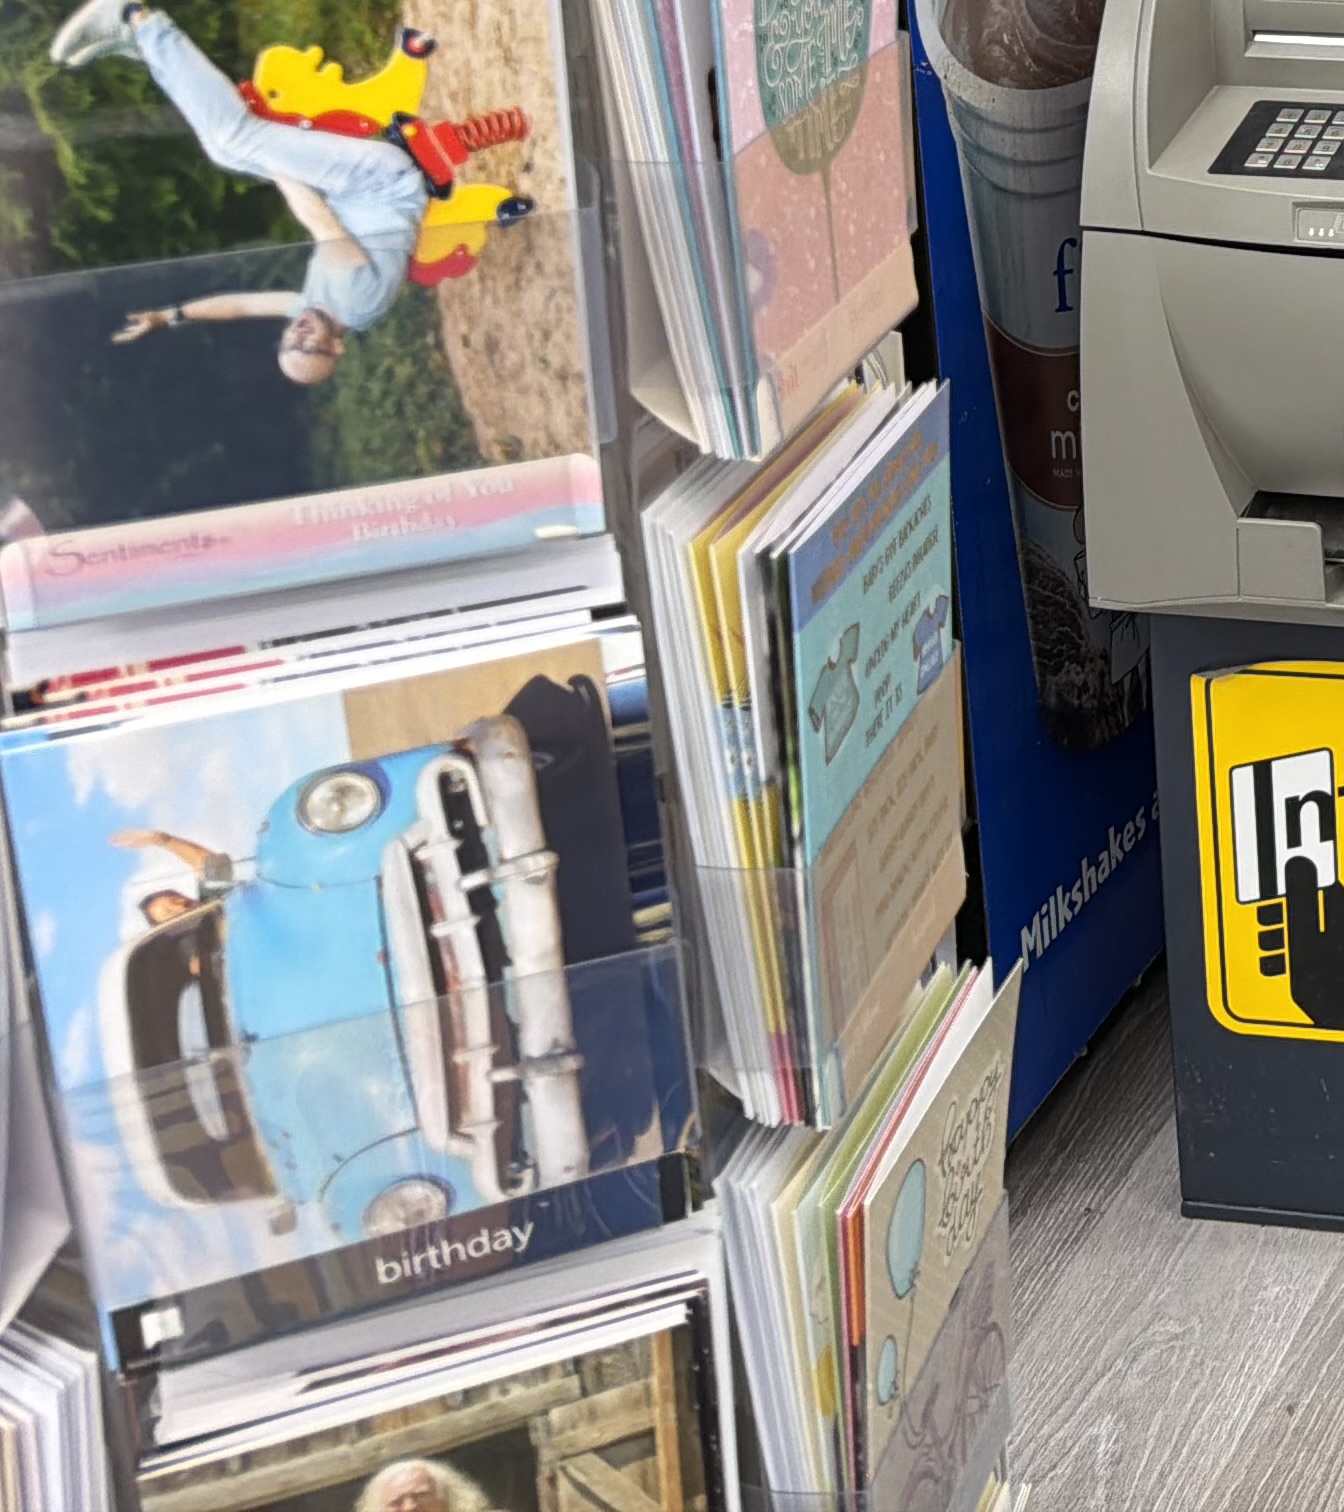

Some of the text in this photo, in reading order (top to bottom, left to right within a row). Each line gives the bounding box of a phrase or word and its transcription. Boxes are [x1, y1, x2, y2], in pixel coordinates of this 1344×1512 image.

[290, 488, 420, 528] Thinking
[351, 510, 459, 544] Birthday
[1020, 804, 1148, 975] Milkshakes
[375, 1218, 537, 1286] birthday
